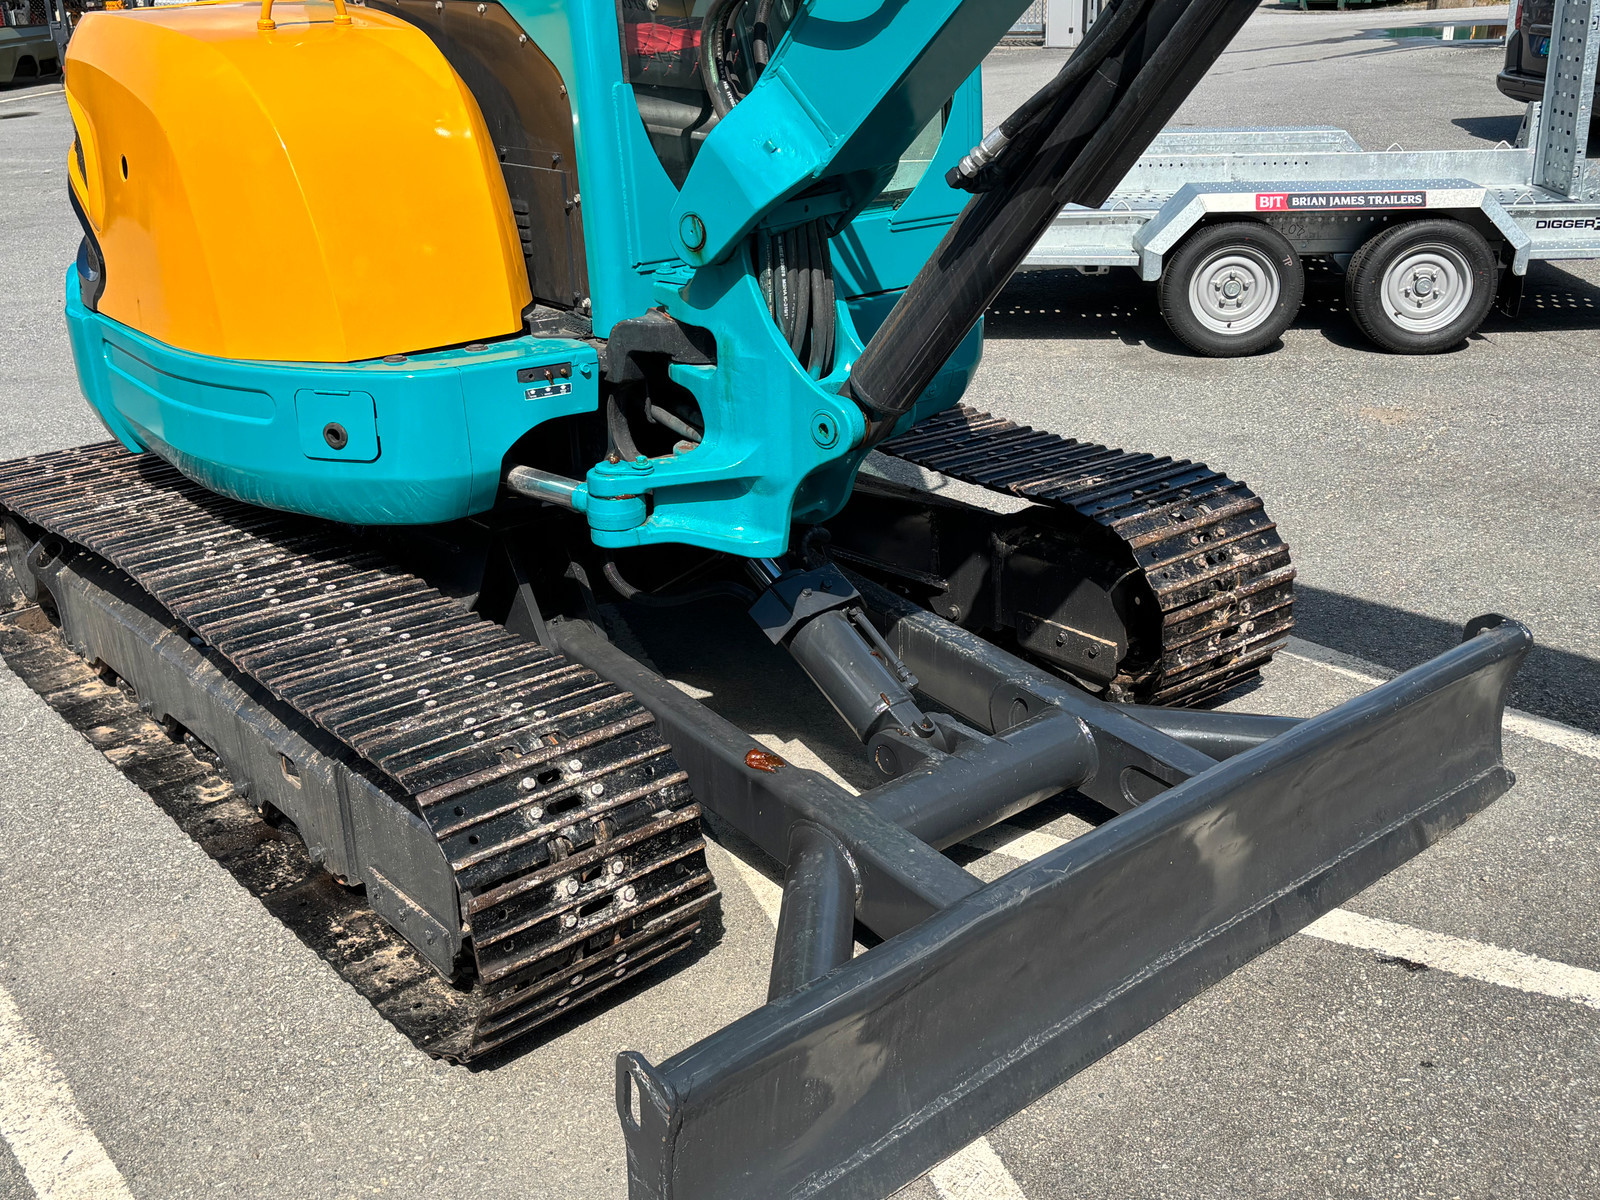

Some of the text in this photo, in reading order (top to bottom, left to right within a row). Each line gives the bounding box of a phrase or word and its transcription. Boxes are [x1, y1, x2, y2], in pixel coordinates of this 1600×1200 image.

[1259, 196, 1284, 208] BJT
[1291, 194, 1423, 206] BRIAN JAMES TRAILERS
[1536, 219, 1595, 229] DIGGER
